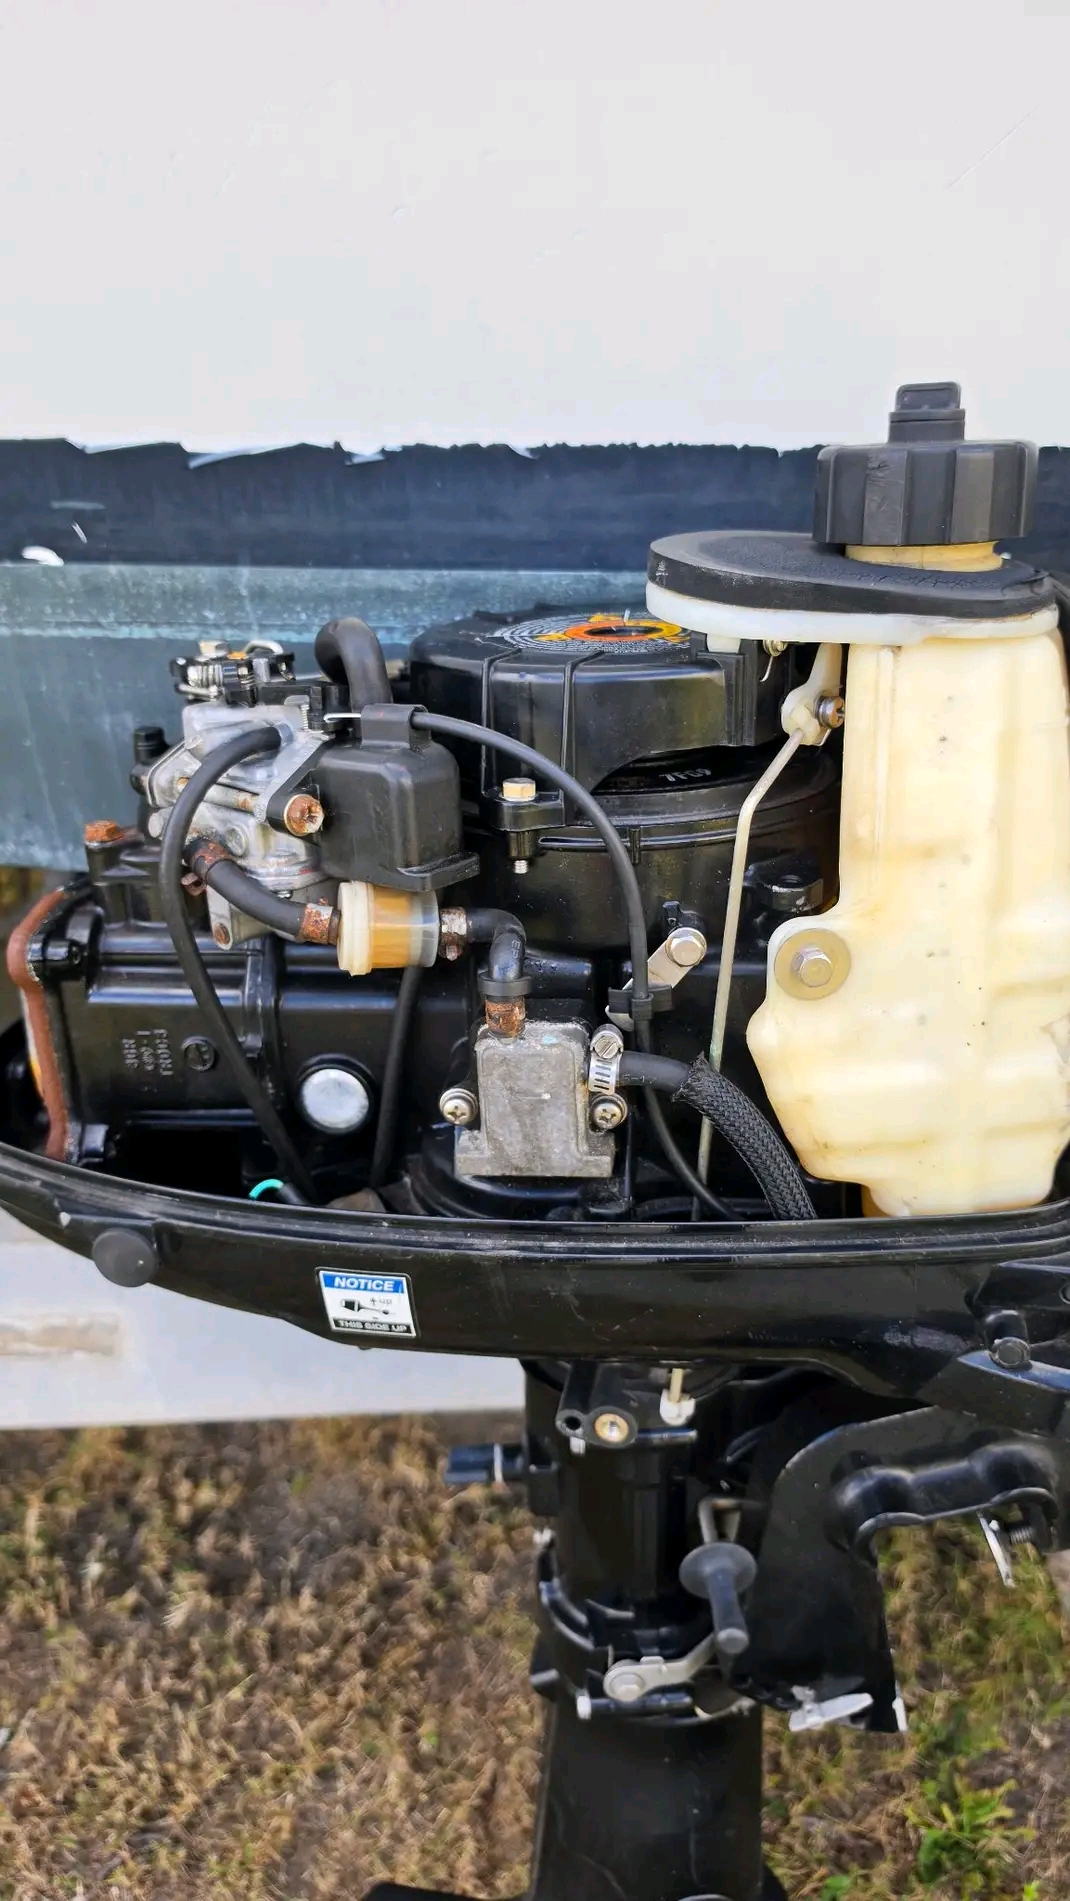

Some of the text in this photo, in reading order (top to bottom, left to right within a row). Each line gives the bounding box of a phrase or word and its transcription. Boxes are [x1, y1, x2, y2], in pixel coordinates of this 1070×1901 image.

[334, 1276, 395, 1292] NOTICE
[338, 1320, 407, 1332] THIS SIDE UP
